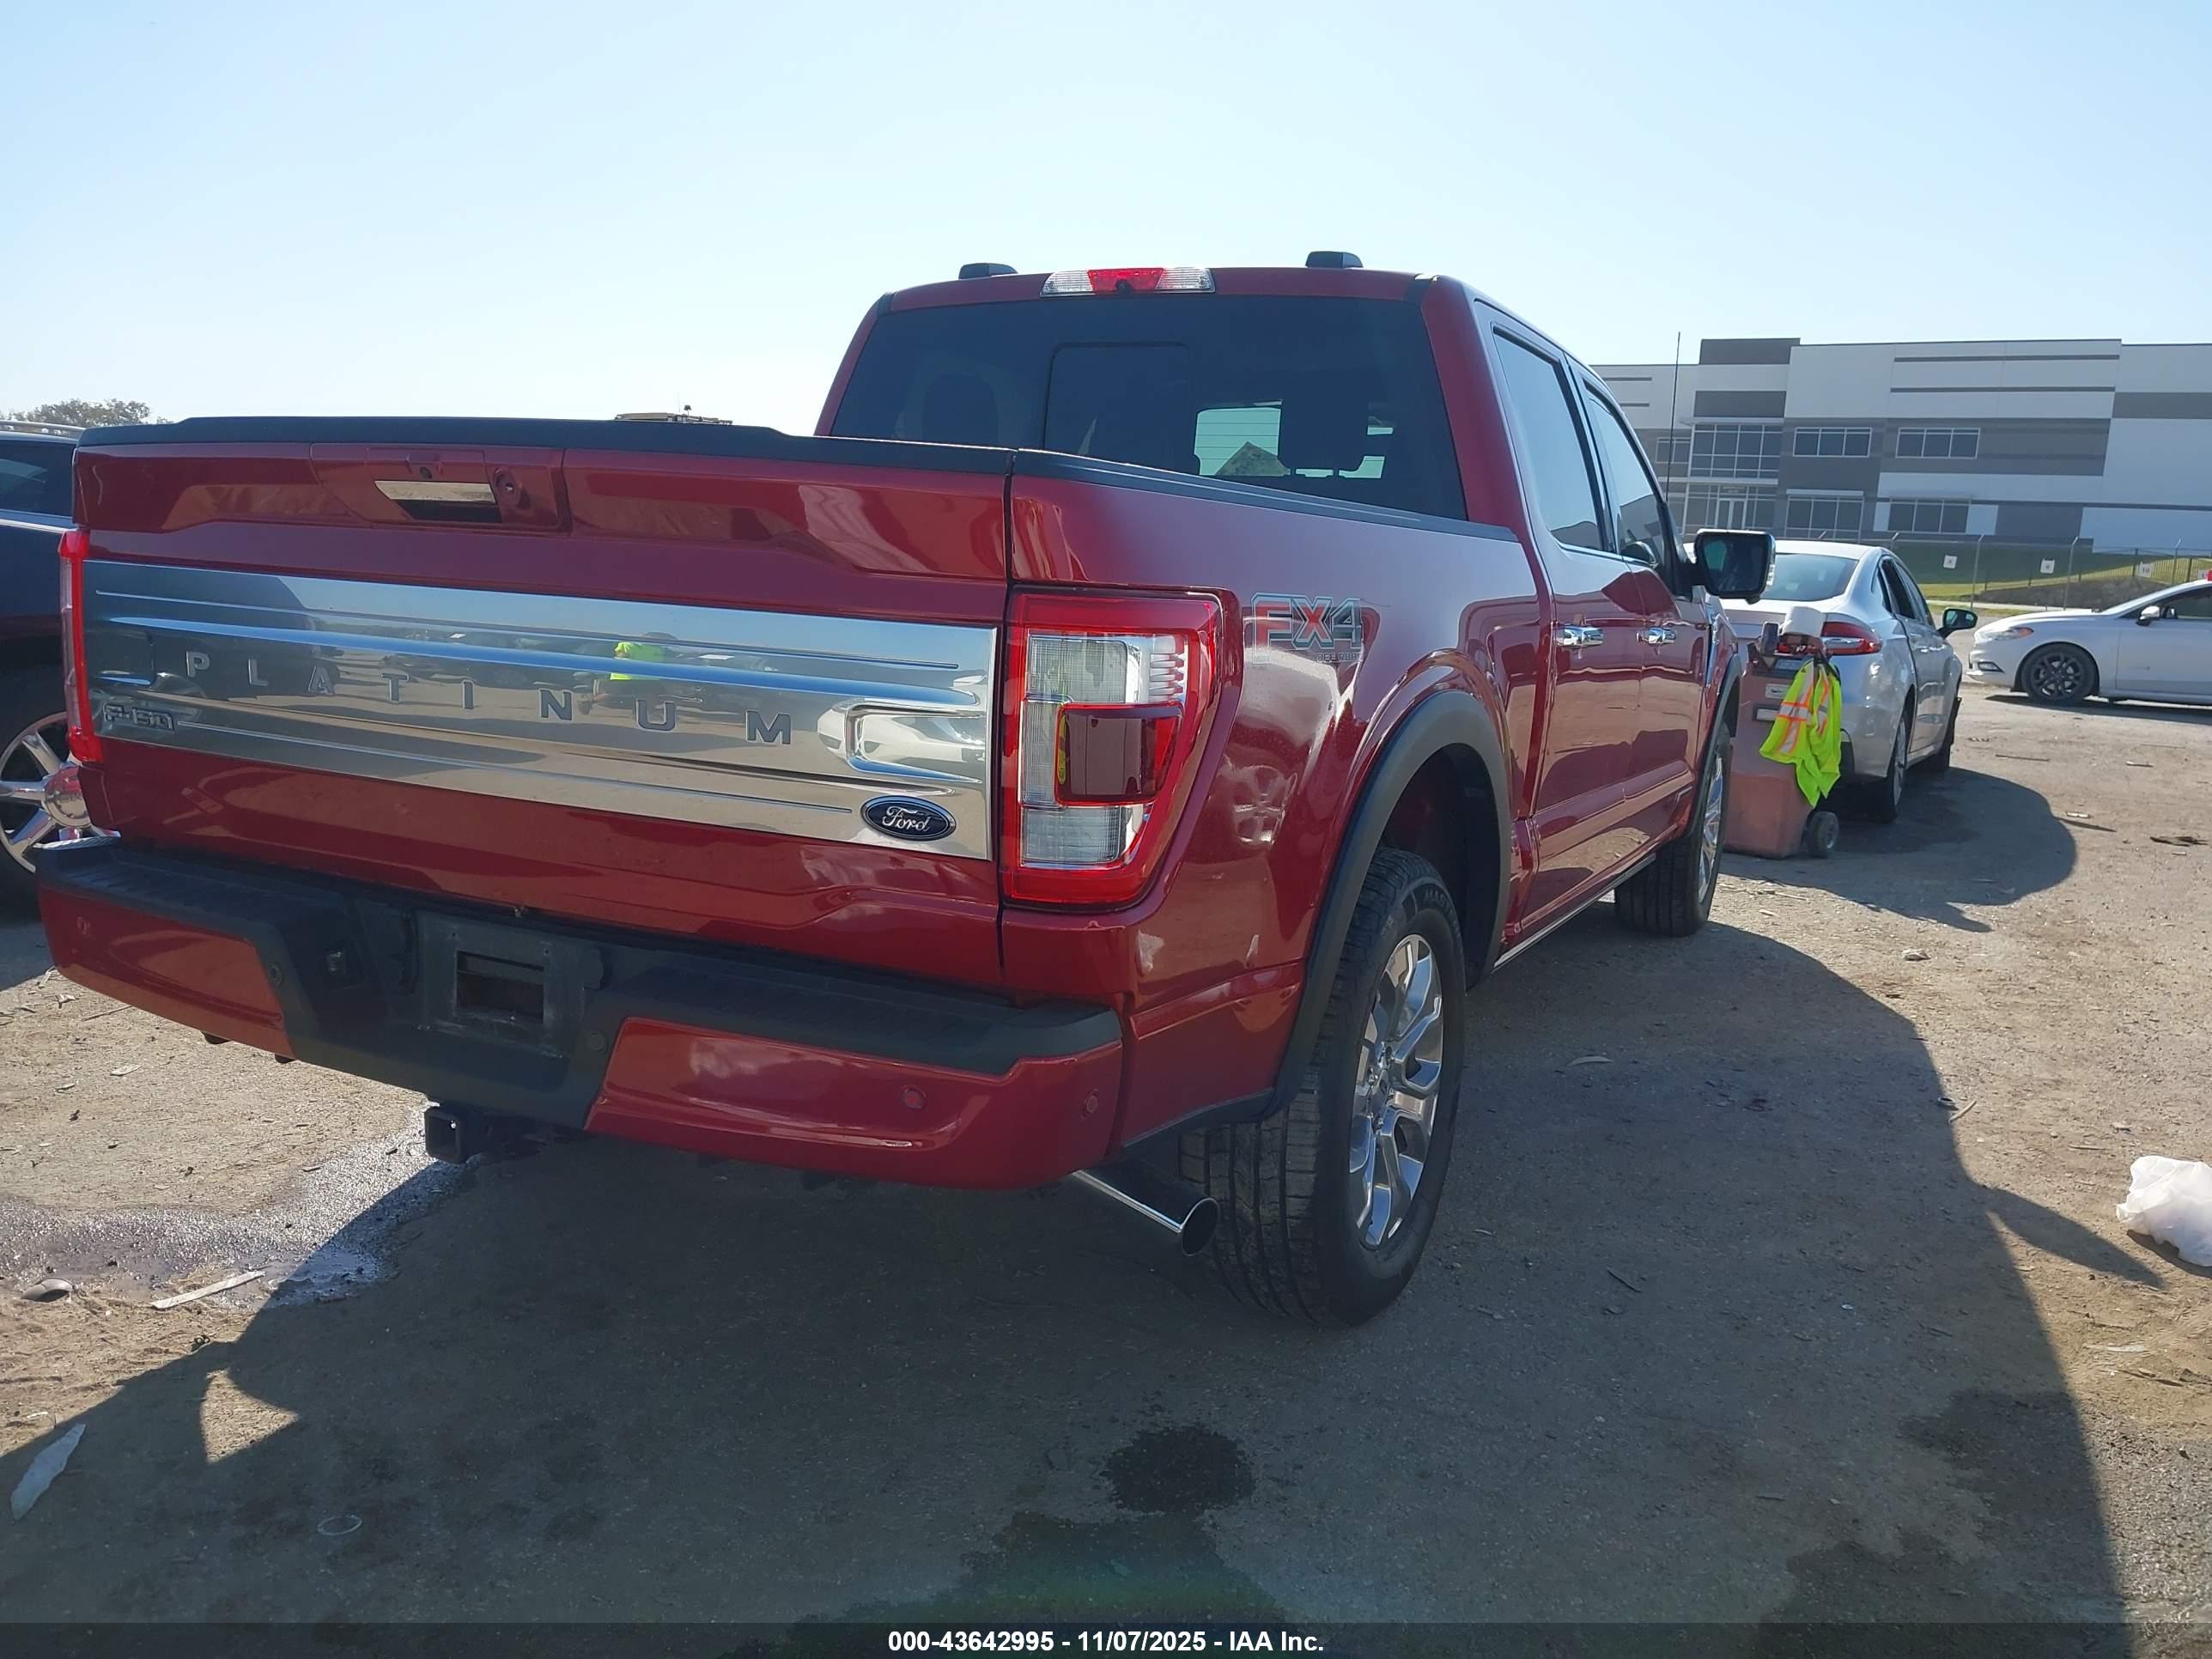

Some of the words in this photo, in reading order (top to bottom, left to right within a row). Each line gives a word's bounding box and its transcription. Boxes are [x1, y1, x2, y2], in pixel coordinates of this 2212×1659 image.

[1251, 592, 1364, 664] FX4
[185, 650, 791, 745] PLATINUM
[881, 805, 932, 831] Ford
